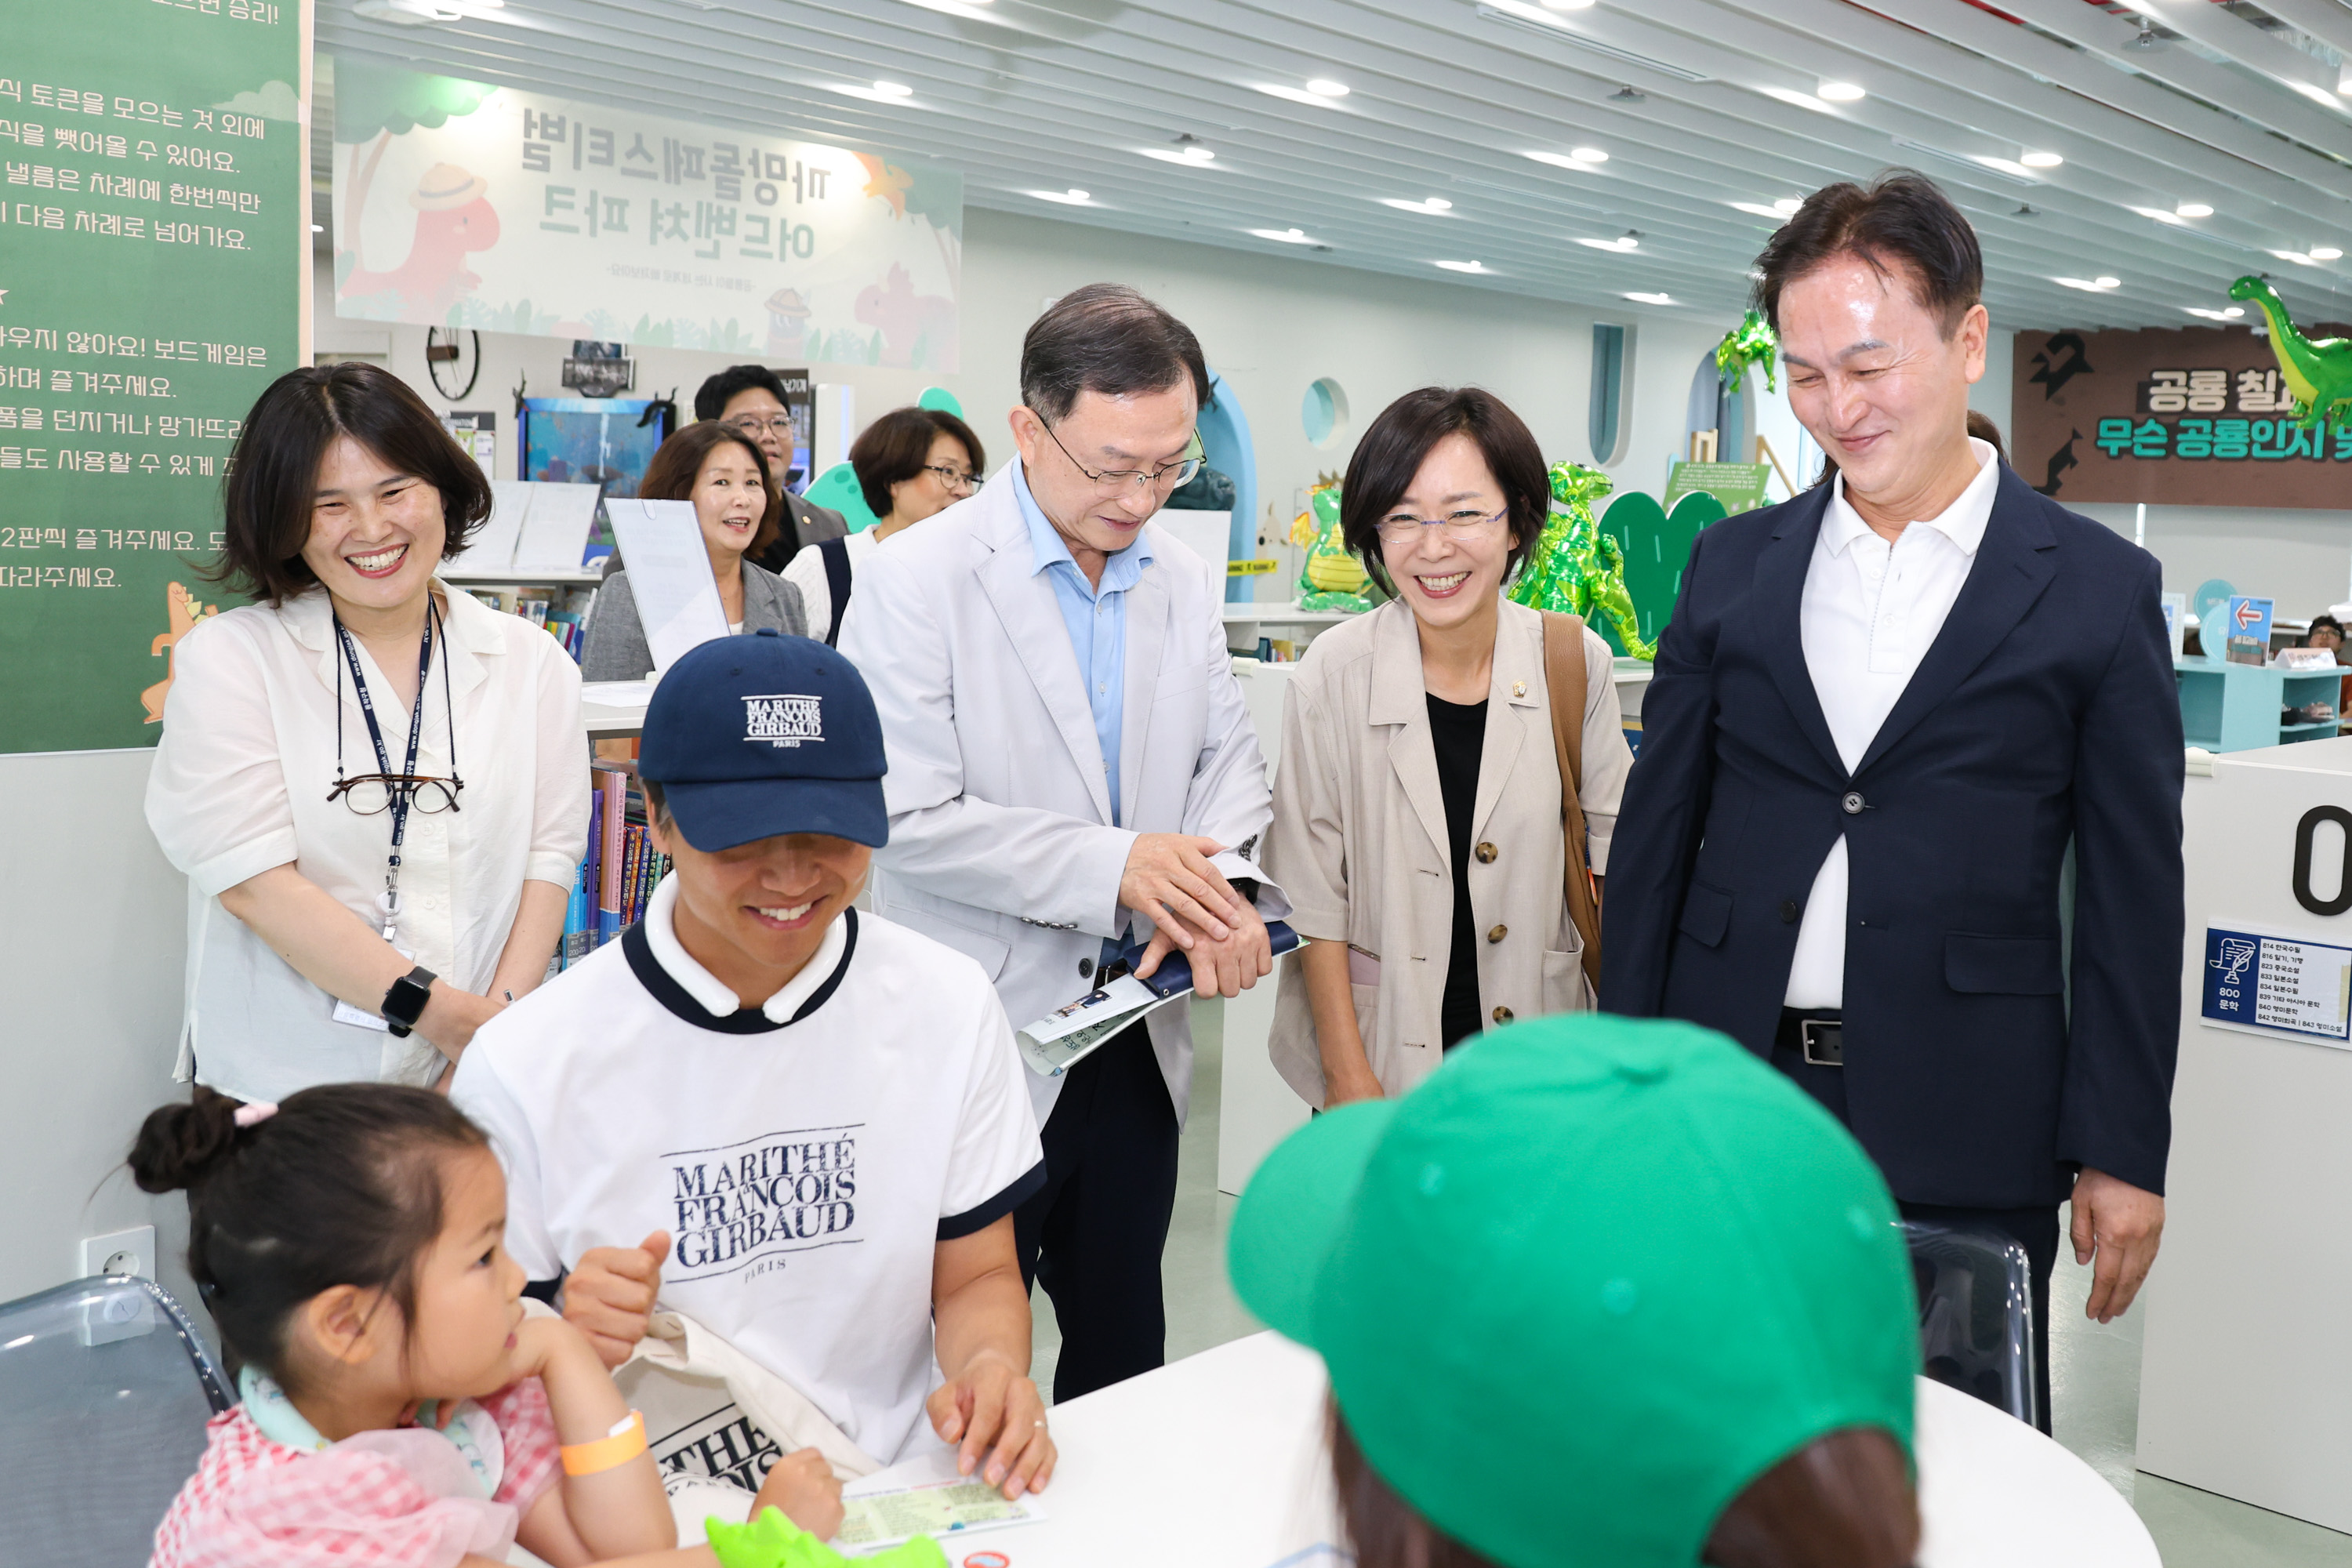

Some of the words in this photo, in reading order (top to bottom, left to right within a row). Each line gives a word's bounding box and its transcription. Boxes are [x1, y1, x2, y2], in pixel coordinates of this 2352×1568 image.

[31, 84, 104, 115] 토큰을
[114, 97, 183, 127] 모으는
[193, 110, 212, 132] 것
[221, 114, 263, 140] 외에
[55, 128, 127, 158] 뺏어올
[136, 140, 158, 161] 수
[166, 144, 240, 172] 있어요.
[6, 162, 80, 191] 낼름은
[90, 173, 160, 201] 차례에
[169, 183, 261, 214] 한번씩만
[16, 204, 65, 229] 다음
[75, 211, 145, 238] 차례로
[154, 221, 250, 249] 넘어가요.
[67, 332, 144, 357] 않아요!
[154, 339, 267, 367] 보드게임은
[50, 370, 176, 397] 즐겨주세요.
[2149, 369, 2227, 412] 공룡
[54, 410, 152, 435] 던지거나
[2096, 419, 2169, 456] 무슨
[2176, 419, 2325, 459] 공룡인지
[59, 450, 132, 473] 사용할
[140, 454, 161, 474] 수
[170, 455, 212, 476] 있게
[2, 528, 65, 548] 2판씩
[75, 529, 200, 550] 즐겨주세요.
[747, 722, 822, 736] GIRBAUD
[2275, 945, 2300, 953] 한국수필
[2274, 964, 2299, 974] 중국소설
[2274, 975, 2299, 984] 일본소설
[2220, 988, 2240, 998] 800
[2274, 985, 2299, 994] 일본수필
[2219, 1000, 2239, 1011] 문학
[2273, 1006, 2298, 1014] 영미문학
[2271, 1016, 2296, 1025] 영미희곡
[2316, 1023, 2342, 1033] 영미소설
[673, 1132, 855, 1199] MARITHÉ
[674, 1170, 856, 1233] FRANÇOIS
[676, 1201, 855, 1268] GIRBAUD
[745, 1258, 786, 1284] PARIS
